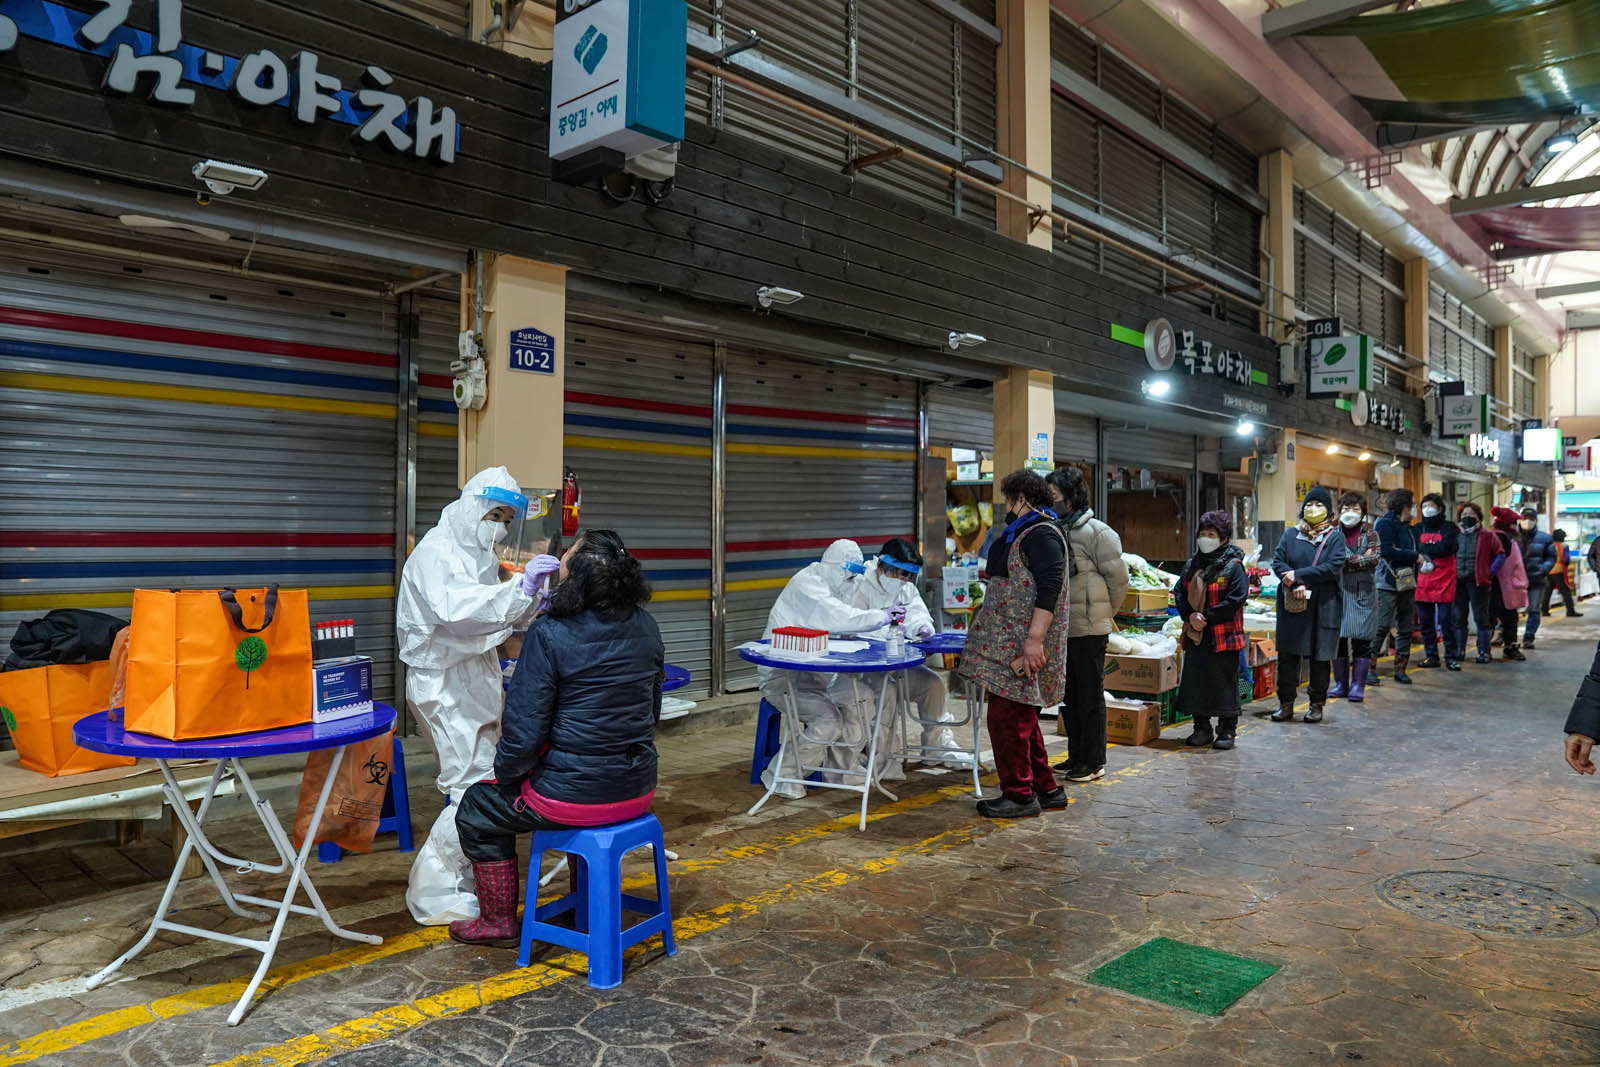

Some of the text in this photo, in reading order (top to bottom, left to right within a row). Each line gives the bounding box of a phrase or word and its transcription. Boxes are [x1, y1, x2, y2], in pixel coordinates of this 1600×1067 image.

[1314, 322, 1332, 335] 08
[515, 349, 549, 368] 10-2
[1182, 328, 1252, 385] 목포야채
